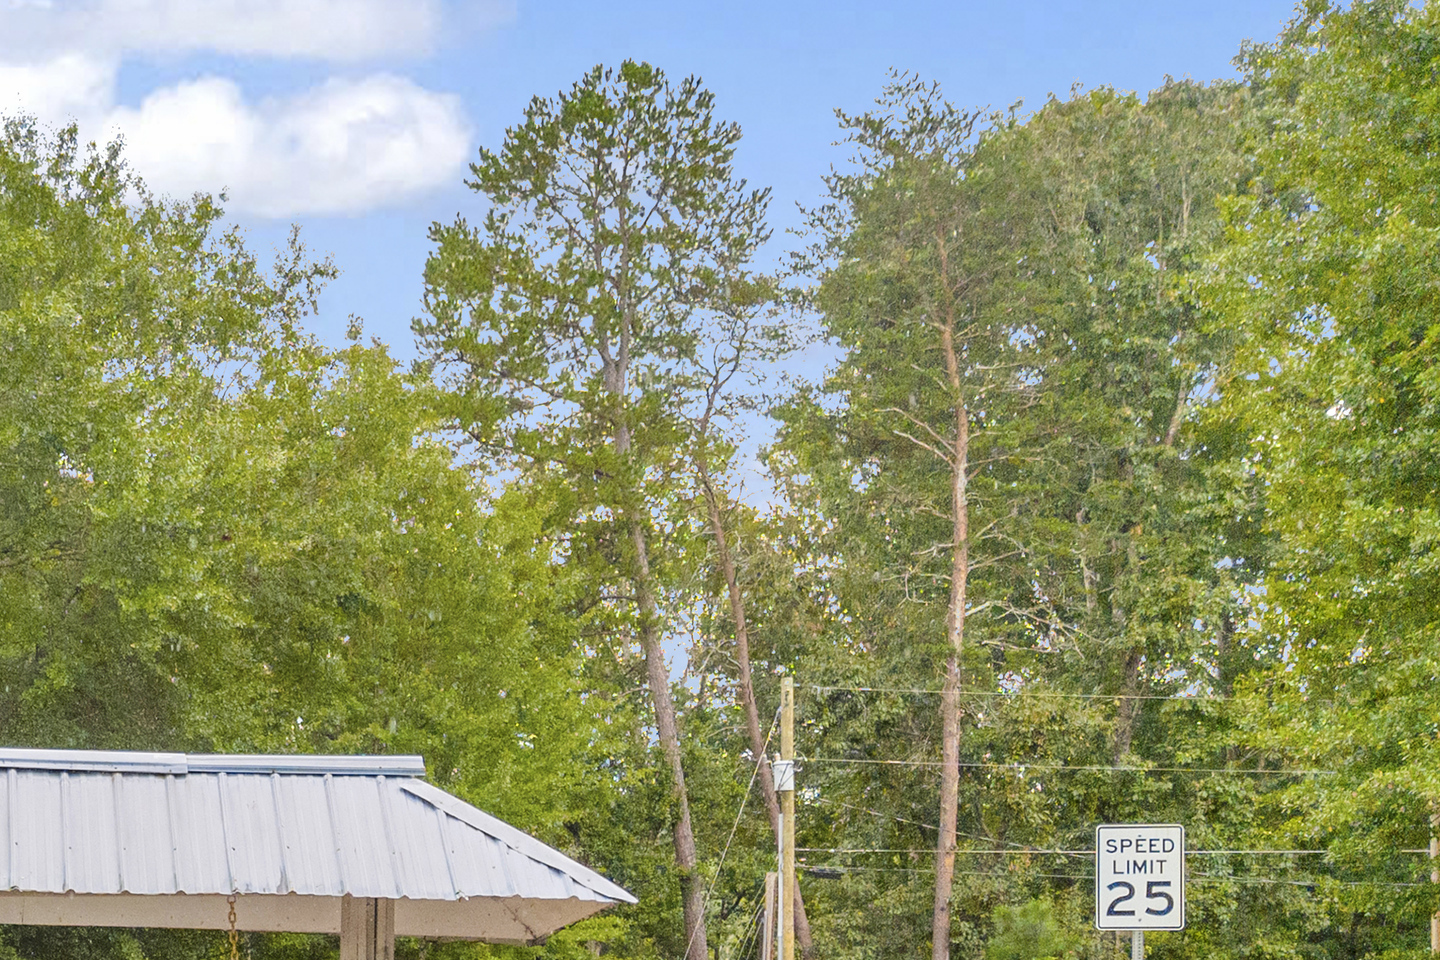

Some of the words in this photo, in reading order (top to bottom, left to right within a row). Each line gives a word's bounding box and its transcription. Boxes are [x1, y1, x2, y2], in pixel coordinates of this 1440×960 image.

[1106, 838, 1175, 854] SPEED
[1113, 860, 1167, 875] LIMIT
[1106, 881, 1174, 916] 25
